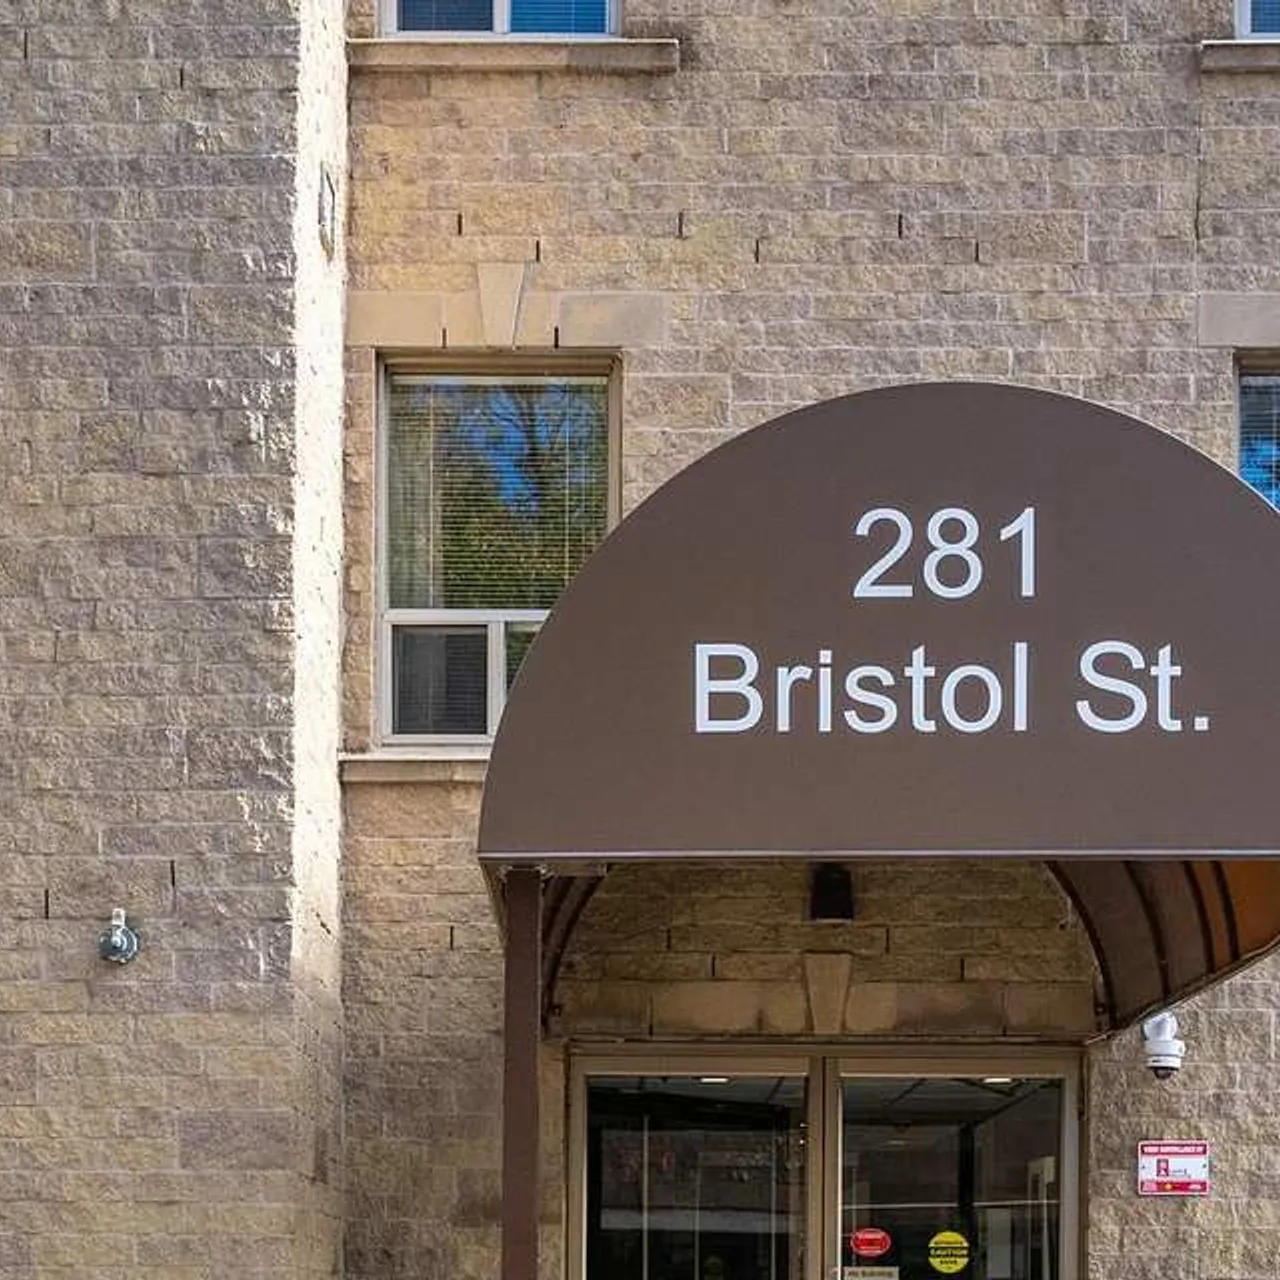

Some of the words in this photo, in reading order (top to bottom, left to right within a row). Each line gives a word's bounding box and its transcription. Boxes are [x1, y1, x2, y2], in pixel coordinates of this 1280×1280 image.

[852, 506, 1036, 598] 281
[694, 640, 1028, 733] Bristol
[1075, 639, 1209, 733] St.
